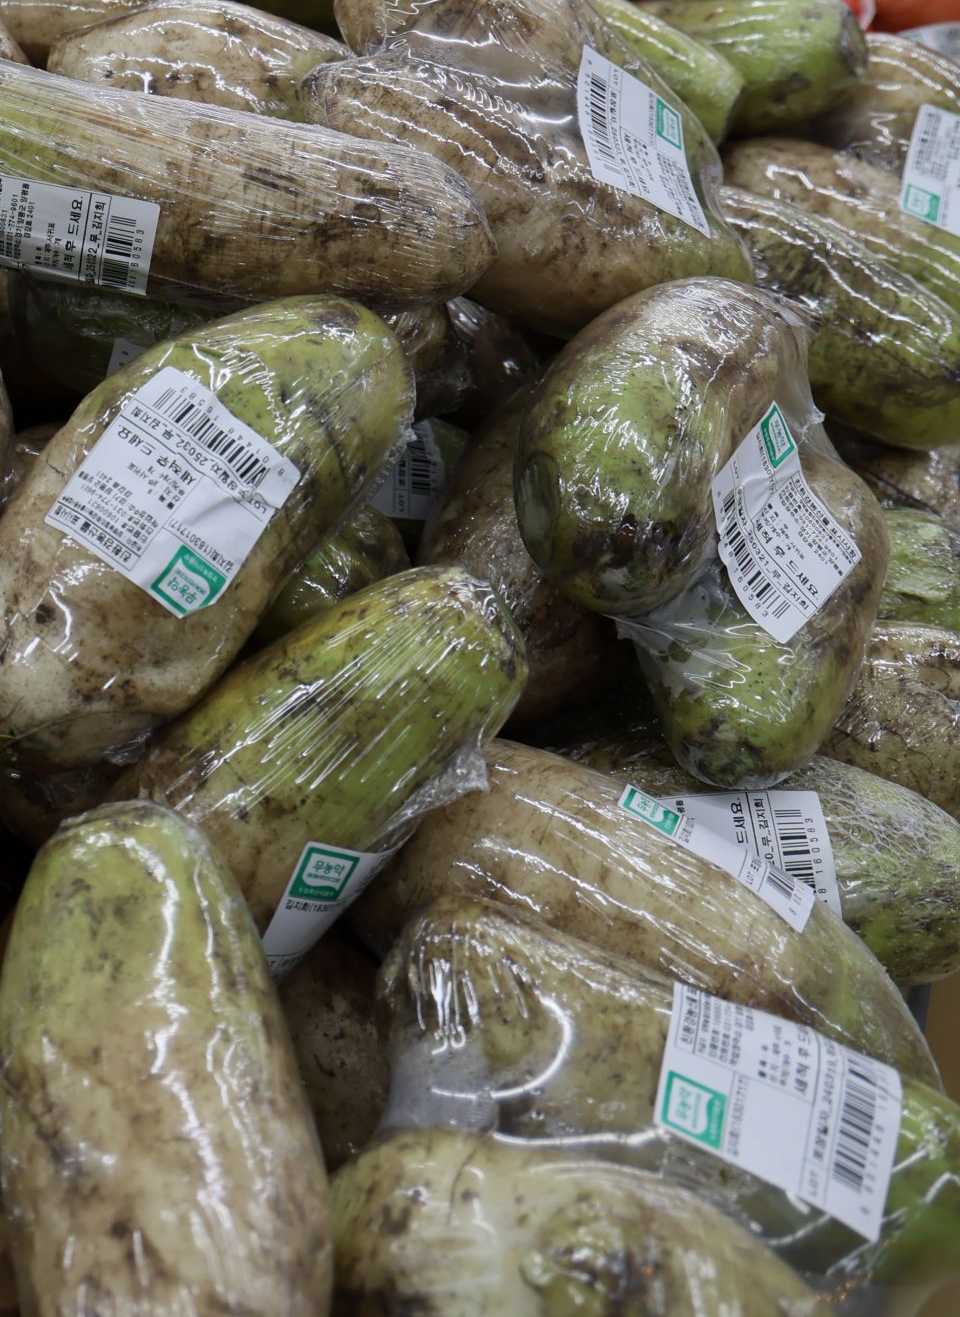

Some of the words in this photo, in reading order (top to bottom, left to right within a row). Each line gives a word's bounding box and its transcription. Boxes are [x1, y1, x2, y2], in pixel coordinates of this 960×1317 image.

[68, 194, 82, 235] 드세요.
[65, 240, 76, 252] 후
[113, 423, 155, 456] 드세요.
[155, 453, 170, 468] 후
[167, 459, 196, 486] 세척
[277, 467, 285, 476] 8
[53, 505, 80, 524] 표시사항
[79, 521, 132, 562] 친환경농산물
[166, 576, 199, 604] 무농약
[729, 797, 748, 843] 드세요.
[805, 818, 823, 873] 160583
[313, 859, 345, 876] 무농약
[808, 1170, 819, 1197] LOT
